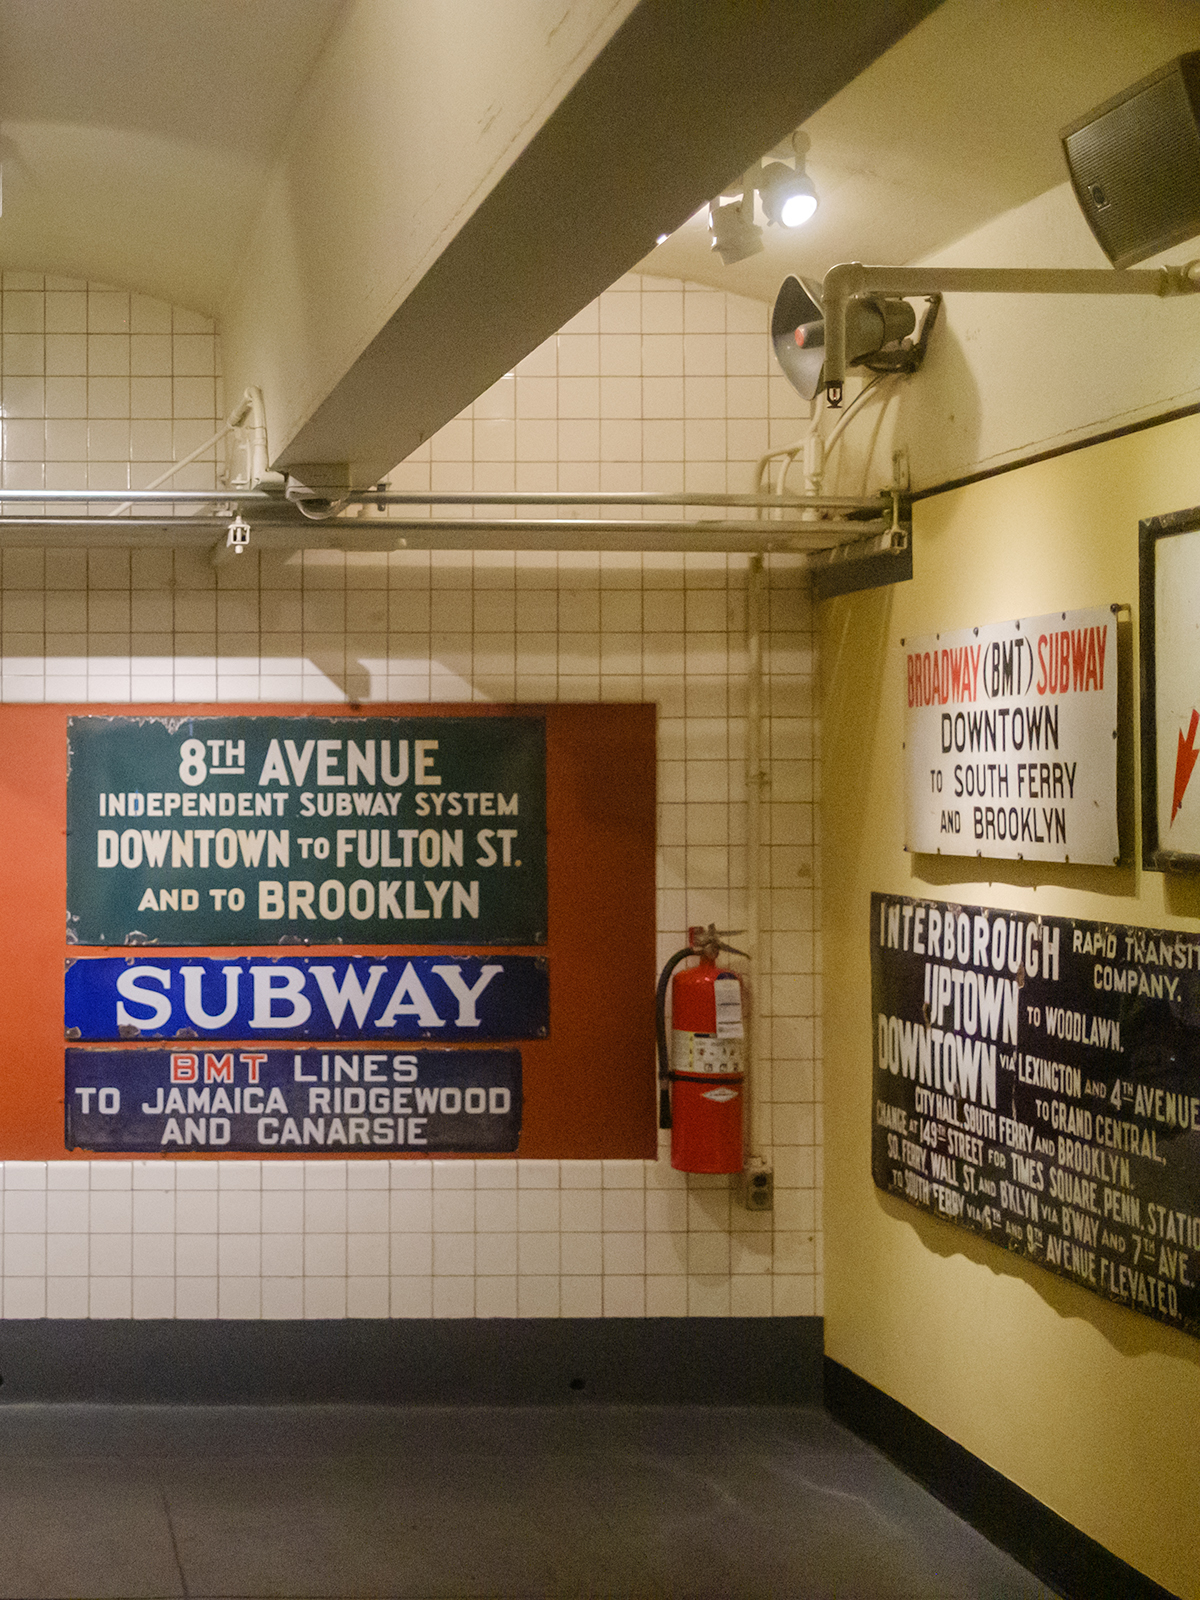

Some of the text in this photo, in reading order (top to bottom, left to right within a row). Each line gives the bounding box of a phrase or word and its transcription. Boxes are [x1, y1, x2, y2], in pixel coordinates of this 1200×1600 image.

[907, 625, 1108, 708] BROADWAY (BMT) SUBWAY
[941, 705, 1059, 754] DOWNTOWN
[179, 738, 442, 786] 8TH AVENUE
[930, 762, 1077, 799] TO SOUTH FERRY
[99, 793, 519, 817] INDEPENDENT SUBWAY SYSTEM
[940, 806, 1066, 844] AND BROOKLYN
[96, 829, 522, 868] DOWNTOWN TO FULTON ST.
[137, 881, 481, 920] AND TO BROOKLYN
[880, 902, 1060, 980] INTERBOROUGH
[1073, 929, 1117, 959] RAPID
[116, 965, 504, 1030] SUBWAY
[1094, 963, 1181, 1002] COMPANY.
[924, 963, 1124, 1053] UPTOWN TO WOODLAWN.
[170, 1053, 419, 1084] BMT LINES
[878, 1013, 1200, 1132] DOWNTOWN VIA LEXINGTON AND 4TH AVENUE
[75, 1086, 511, 1115] TO JAMAICA RIDGEWOOD
[161, 1117, 428, 1145] AND CANARSIE
[915, 1086, 935, 1117] CITY
[963, 1103, 996, 1140] SOUTH
[999, 1115, 1034, 1153] FERRY
[1035, 1136, 1055, 1157] AND
[1057, 1135, 1134, 1190] BROOKLYN.
[1035, 1099, 1167, 1166] TO GRAND CENTRAL,
[947, 1128, 984, 1167] STREET
[988, 1149, 1006, 1169] FOR
[1010, 1152, 1044, 1192] TIMES
[1104, 1186, 1145, 1231] PENN.
[930, 1151, 959, 1187] WALL
[978, 1176, 997, 1198] AND
[1041, 1204, 1059, 1225] VIA
[1102, 1229, 1126, 1253] AND
[1132, 1233, 1155, 1265] 7TH
[1158, 1244, 1195, 1289] AVE.
[1046, 1234, 1097, 1285] AVENUE
